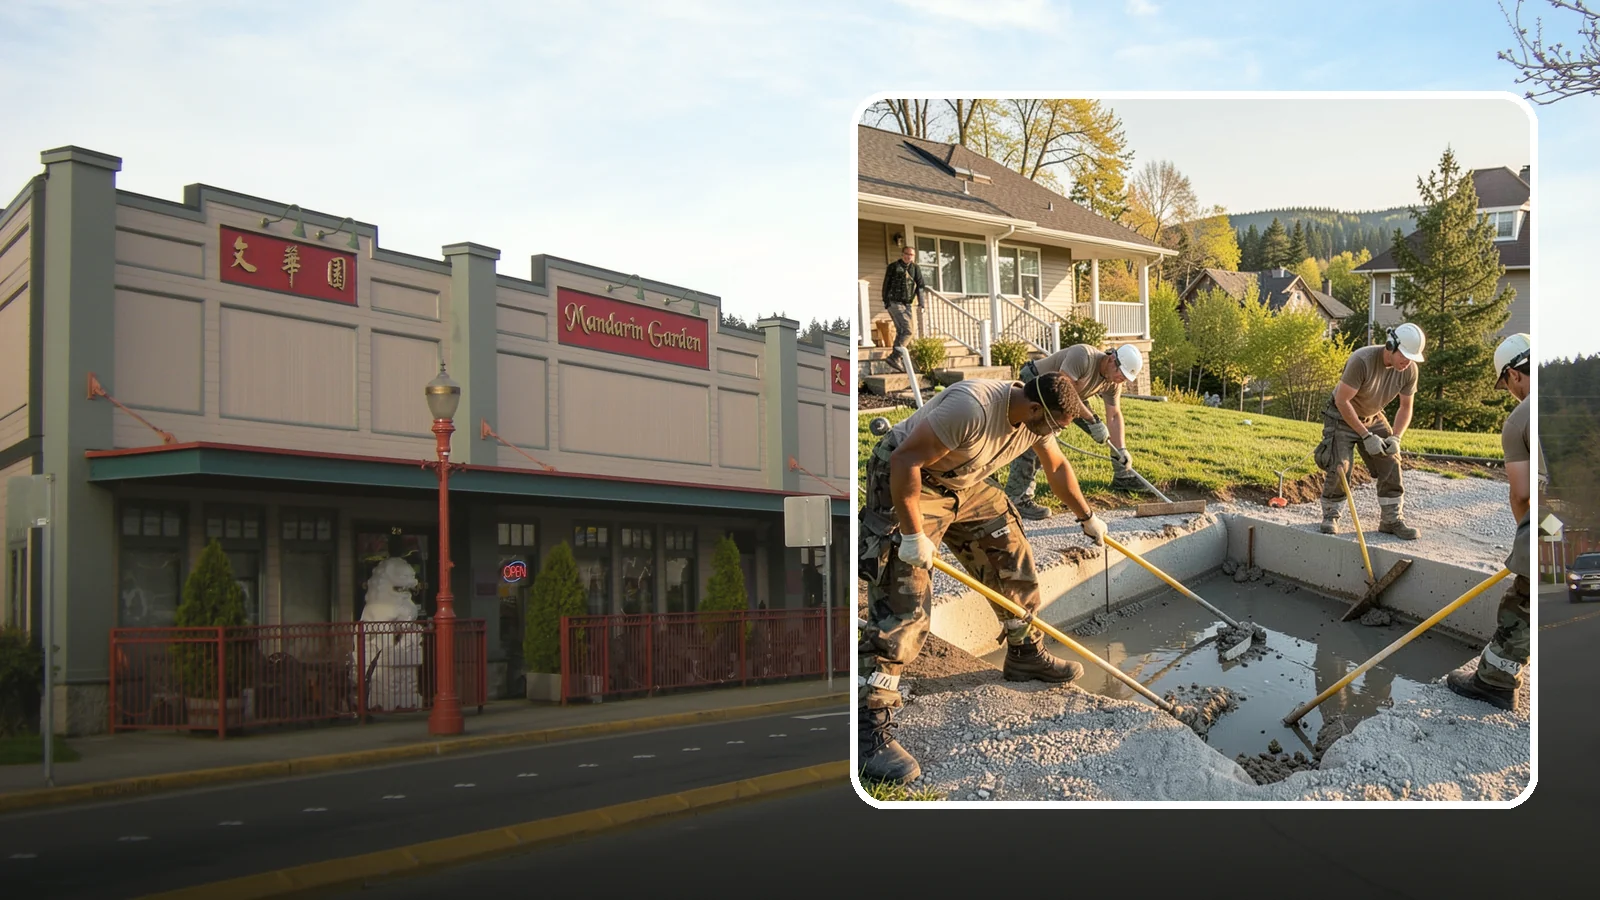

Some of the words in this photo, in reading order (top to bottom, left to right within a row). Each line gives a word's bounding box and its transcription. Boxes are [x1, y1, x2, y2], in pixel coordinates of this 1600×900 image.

[230, 235, 346, 291] 文華園
[564, 302, 644, 341] Mandarin
[647, 320, 702, 352] Garden
[503, 565, 527, 578] OPEN
